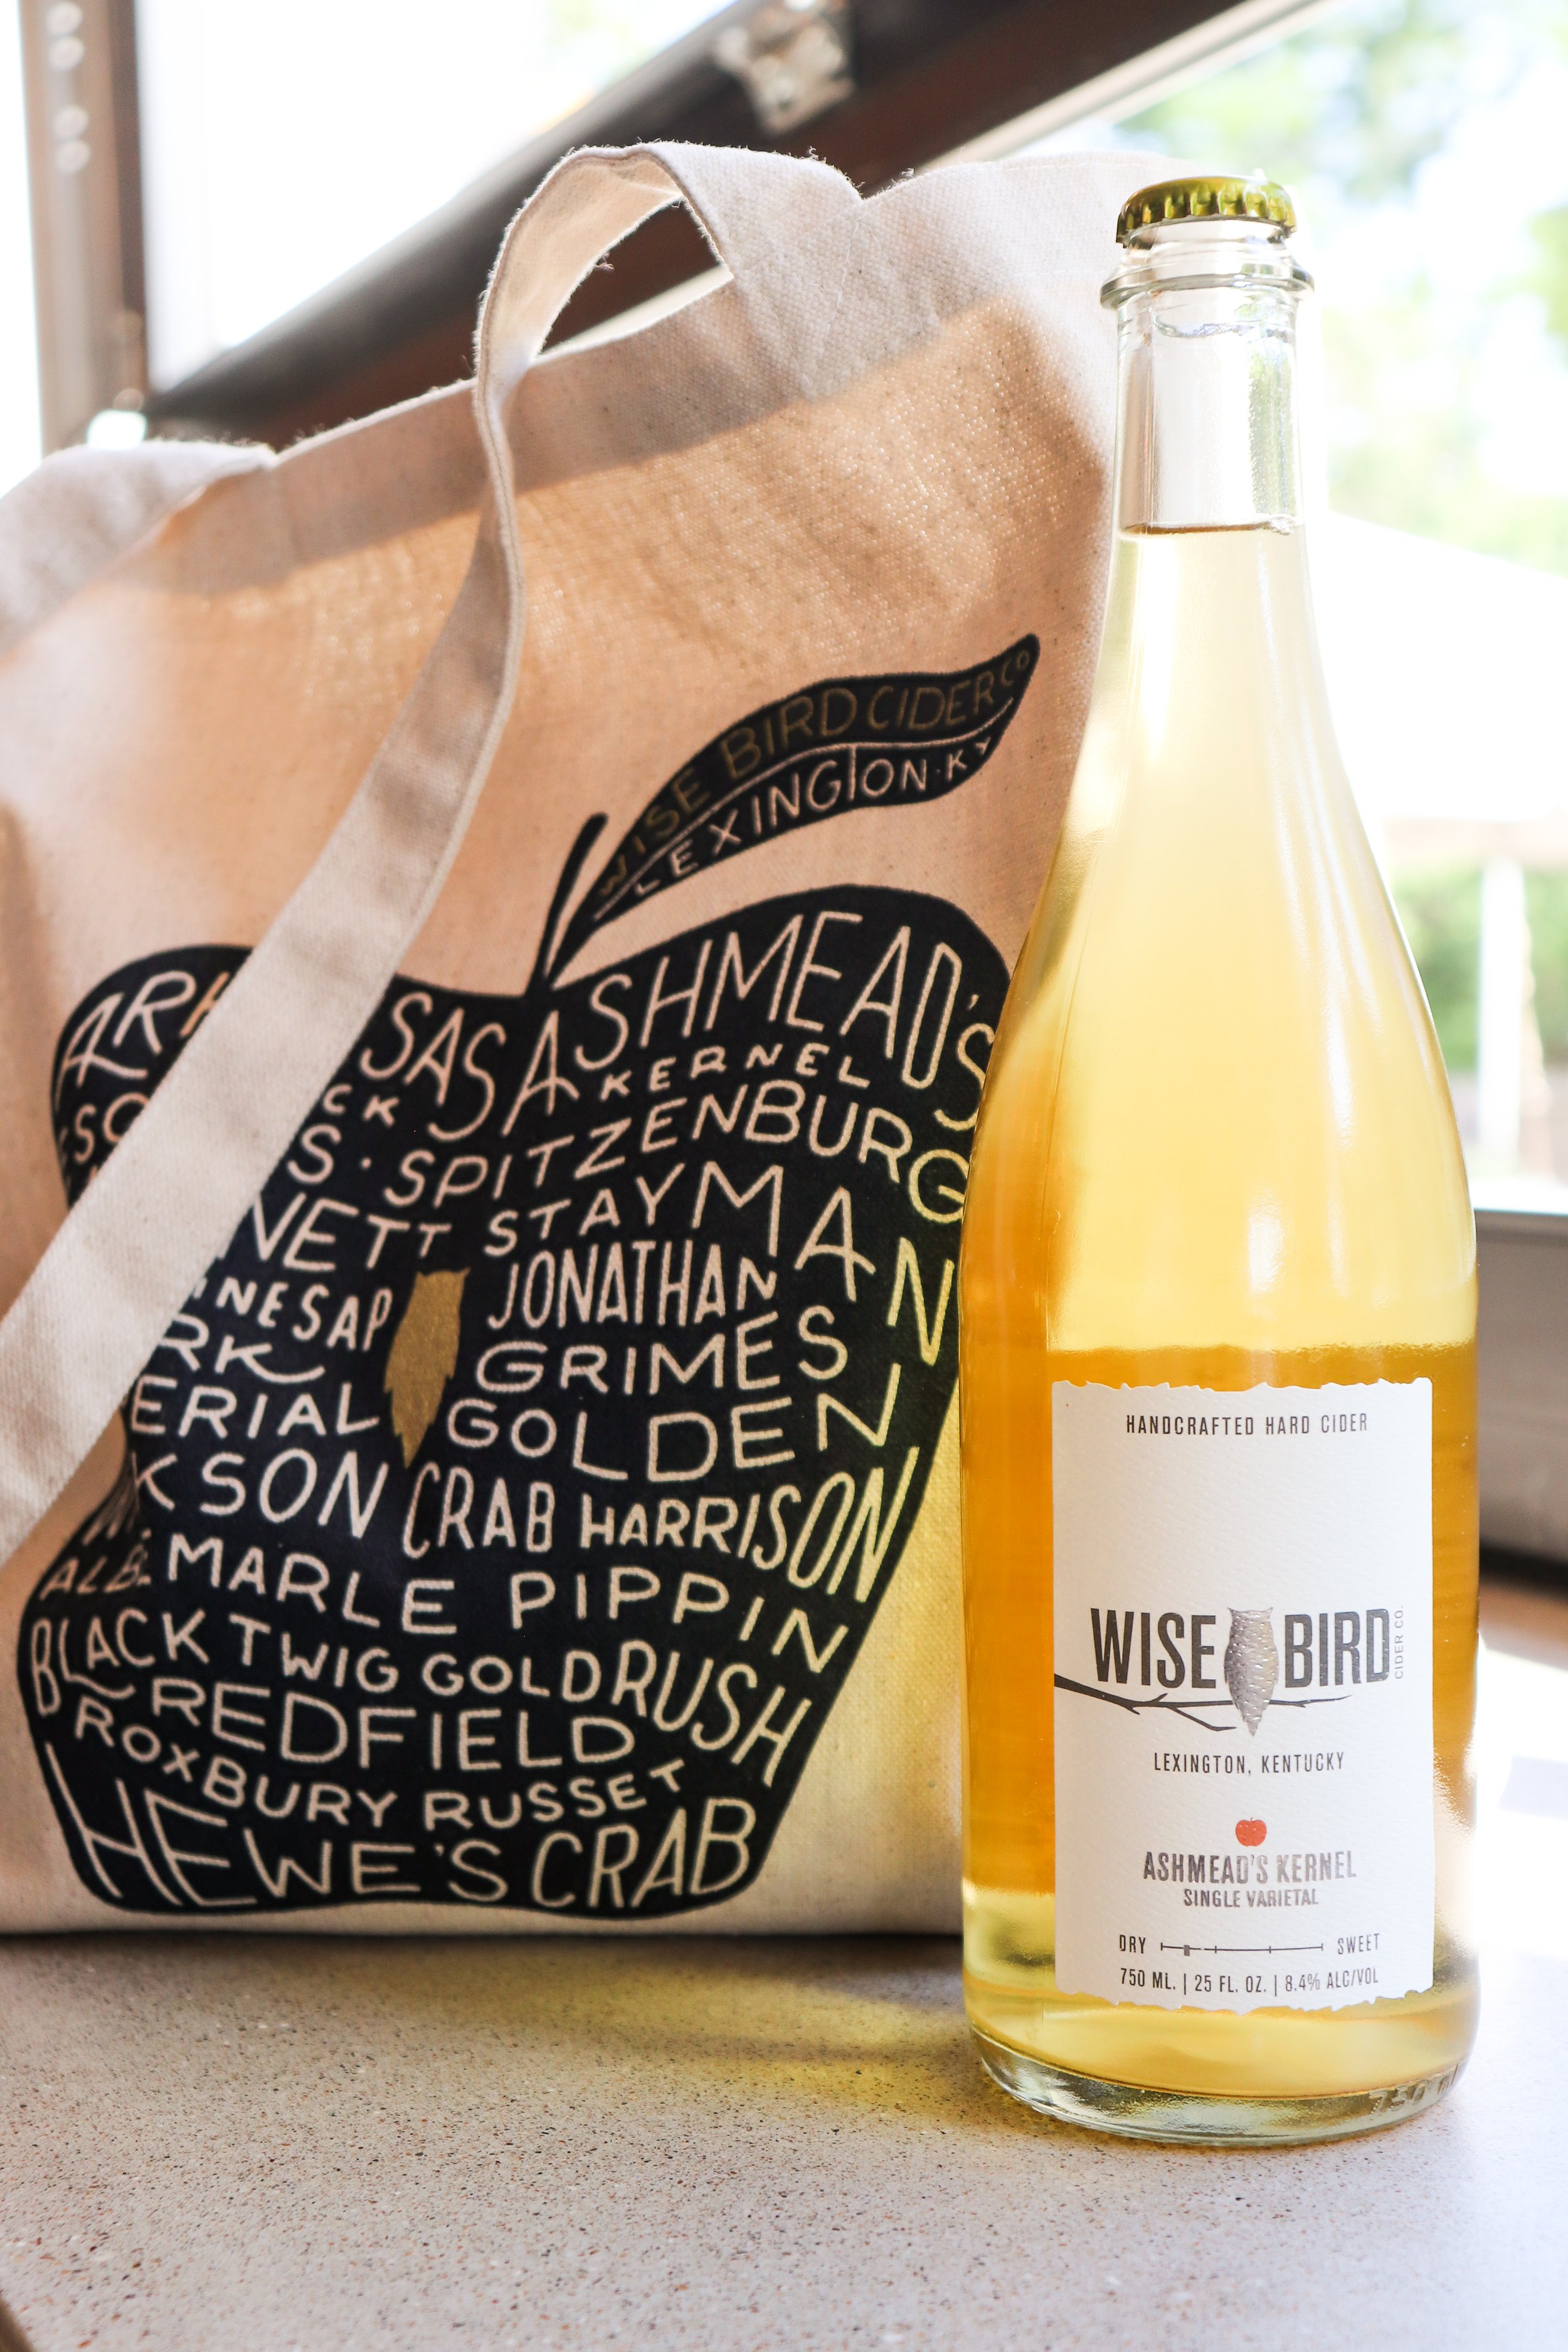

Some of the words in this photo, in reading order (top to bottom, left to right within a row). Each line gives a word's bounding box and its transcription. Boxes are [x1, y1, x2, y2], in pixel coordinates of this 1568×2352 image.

[721, 686, 858, 779] BIRD
[867, 670, 995, 731] CIDER
[502, 911, 997, 1136] ASHMEAD'S
[600, 1042, 871, 1101] KERNEL
[383, 1079, 969, 1224] SPITZENBURG
[484, 1160, 955, 1366] STAYMAN
[488, 1239, 777, 1329] JONATHAN
[475, 1305, 849, 1395] GRIMES
[130, 1375, 380, 1439] ERIAL
[447, 1362, 901, 1482] GOLDEN
[1126, 1414, 1254, 1436] HANDCRAFTED
[1266, 1415, 1310, 1435] HARD
[1321, 1412, 1369, 1433] CIDER
[129, 1448, 389, 1539] KSON
[403, 1461, 556, 1559] CRAB
[580, 1446, 921, 1603] HARRISON
[509, 1566, 849, 1673] PIPPIN
[1090, 1608, 1217, 1690] WISE
[1284, 1608, 1391, 1689] BIRD
[1394, 1605, 1404, 1628] CO.
[1394, 1634, 1404, 1679] CIDER
[31, 1608, 209, 1717] BLACK
[228, 1613, 400, 1694] TWIG
[75, 1696, 399, 1828] ROXBURY
[423, 1757, 686, 1831] RUSSET
[152, 1677, 635, 1771] REDFIELD
[1154, 1752, 1251, 1776] LEXINGTON,
[1261, 1751, 1345, 1772] KENTUCKY
[45, 1742, 509, 1906] HEWE'S
[532, 1796, 757, 1909] CRAB
[1143, 1851, 1268, 1885] ASHMEAD'S
[1277, 1850, 1357, 1883] KERNEL
[1183, 1888, 1241, 1907] SINGLE
[1246, 1888, 1319, 1907] VARIETAL
[1119, 1934, 1146, 1954] DRY
[1337, 1933, 1380, 1955] SWEET
[1120, 1968, 1145, 1987] 750
[1194, 1975, 1212, 1992] 25
[1219, 1976, 1238, 1993] FL.
[1246, 1976, 1266, 1993] OZ.
[1285, 1973, 1320, 1991] 8.4%
[1327, 1967, 1379, 1989] ALC/VOL
